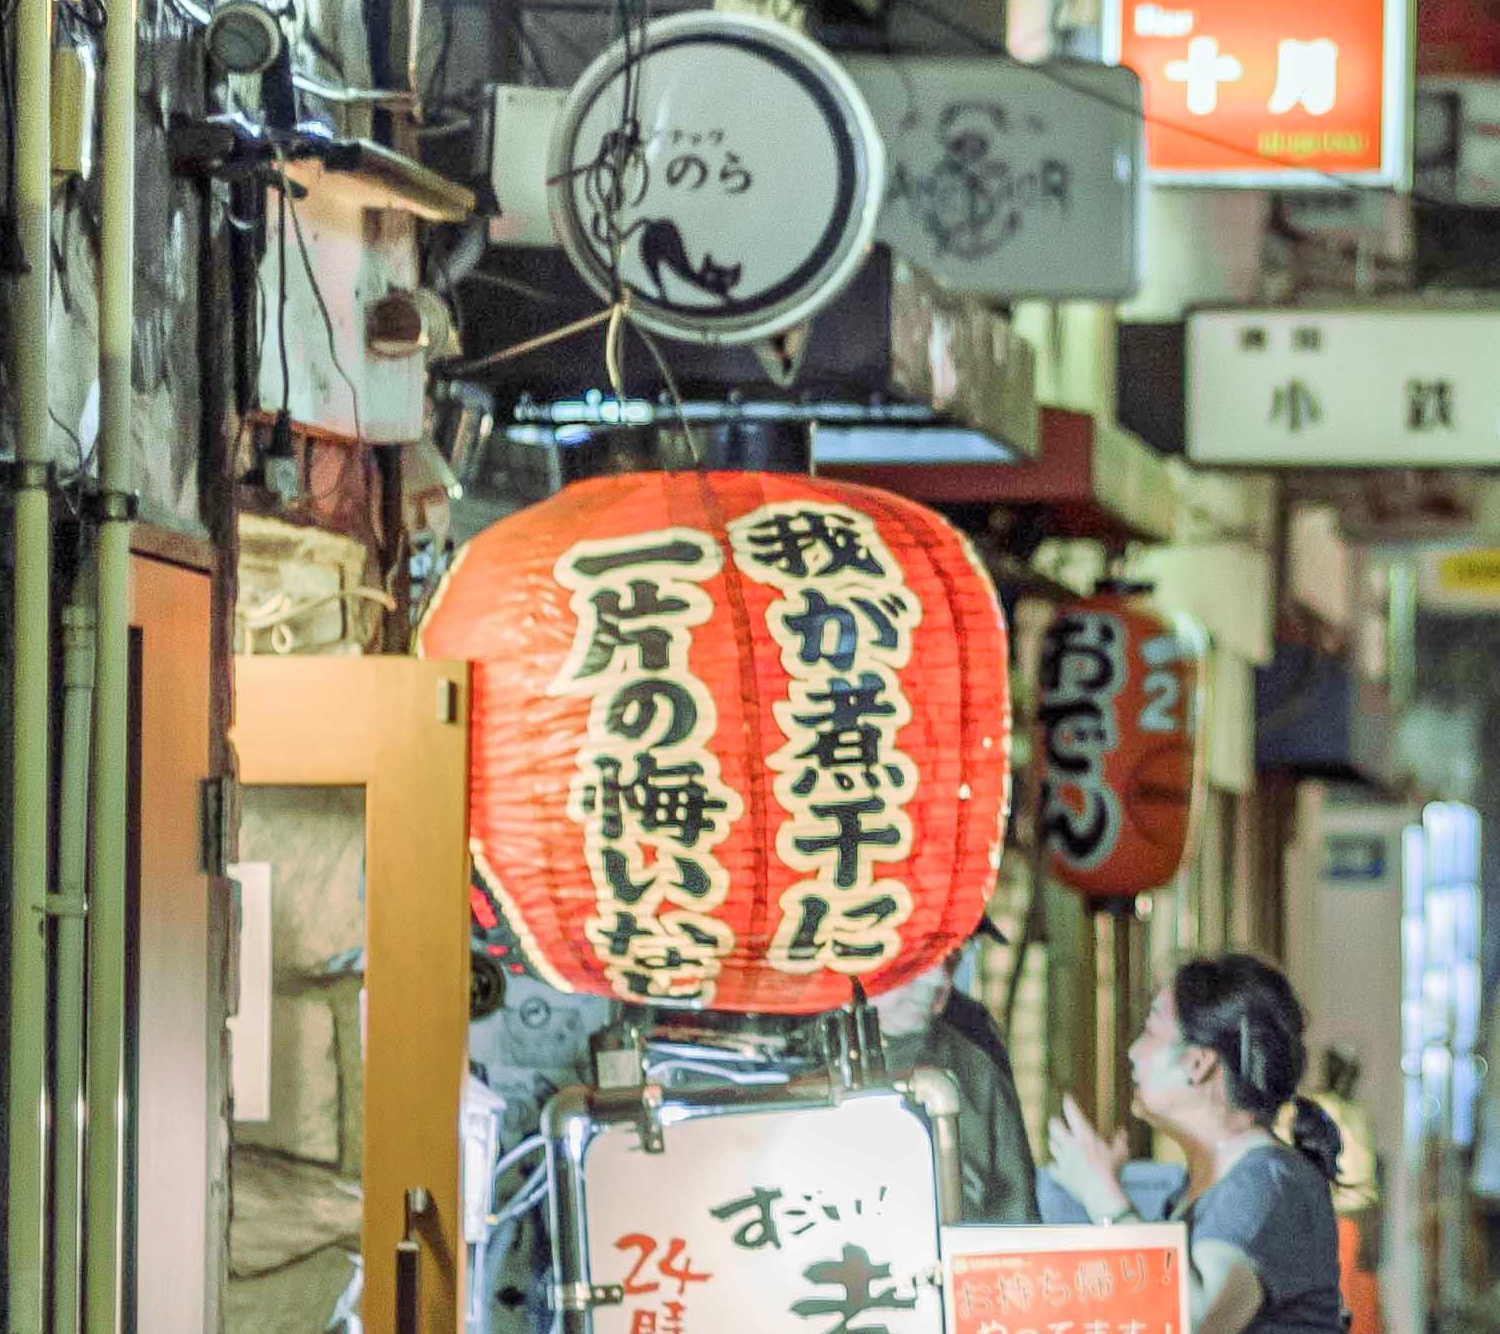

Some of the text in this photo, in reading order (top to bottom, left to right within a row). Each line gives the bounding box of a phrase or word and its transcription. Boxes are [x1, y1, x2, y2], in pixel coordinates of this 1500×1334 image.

[666, 152, 753, 196] のら
[746, 510, 911, 963] 我が煮干に
